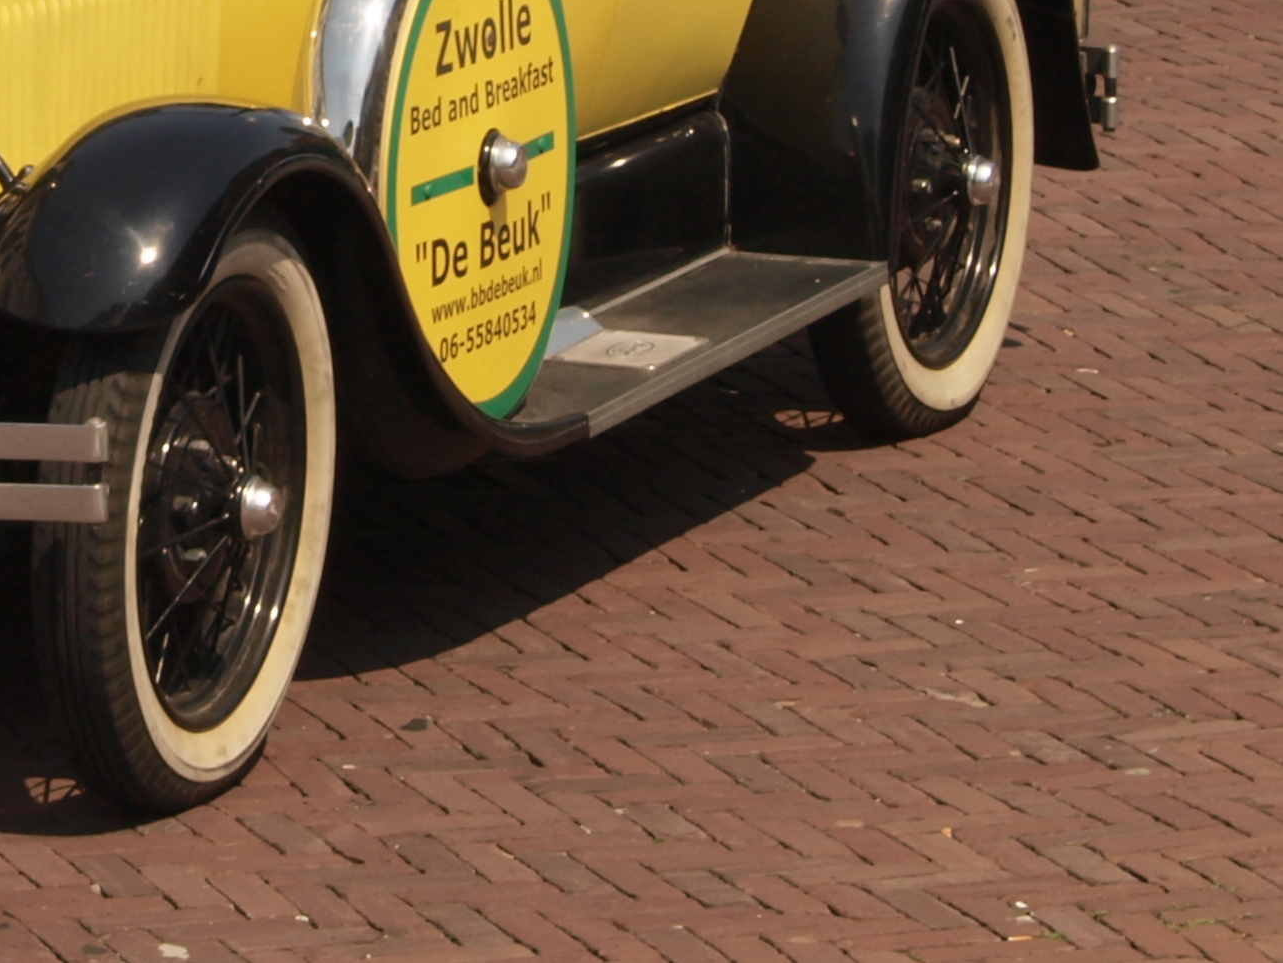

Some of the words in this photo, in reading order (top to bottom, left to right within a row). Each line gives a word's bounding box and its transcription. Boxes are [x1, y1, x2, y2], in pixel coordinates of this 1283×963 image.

[410, 96, 442, 136] Bed
[448, 84, 479, 122] and
[485, 56, 554, 109] Breakfast
[415, 238, 468, 287] "De
[480, 191, 551, 269] Beuk"
[431, 258, 543, 324] www.bbdebeuk.nl
[439, 301, 537, 363] 06-55840534
